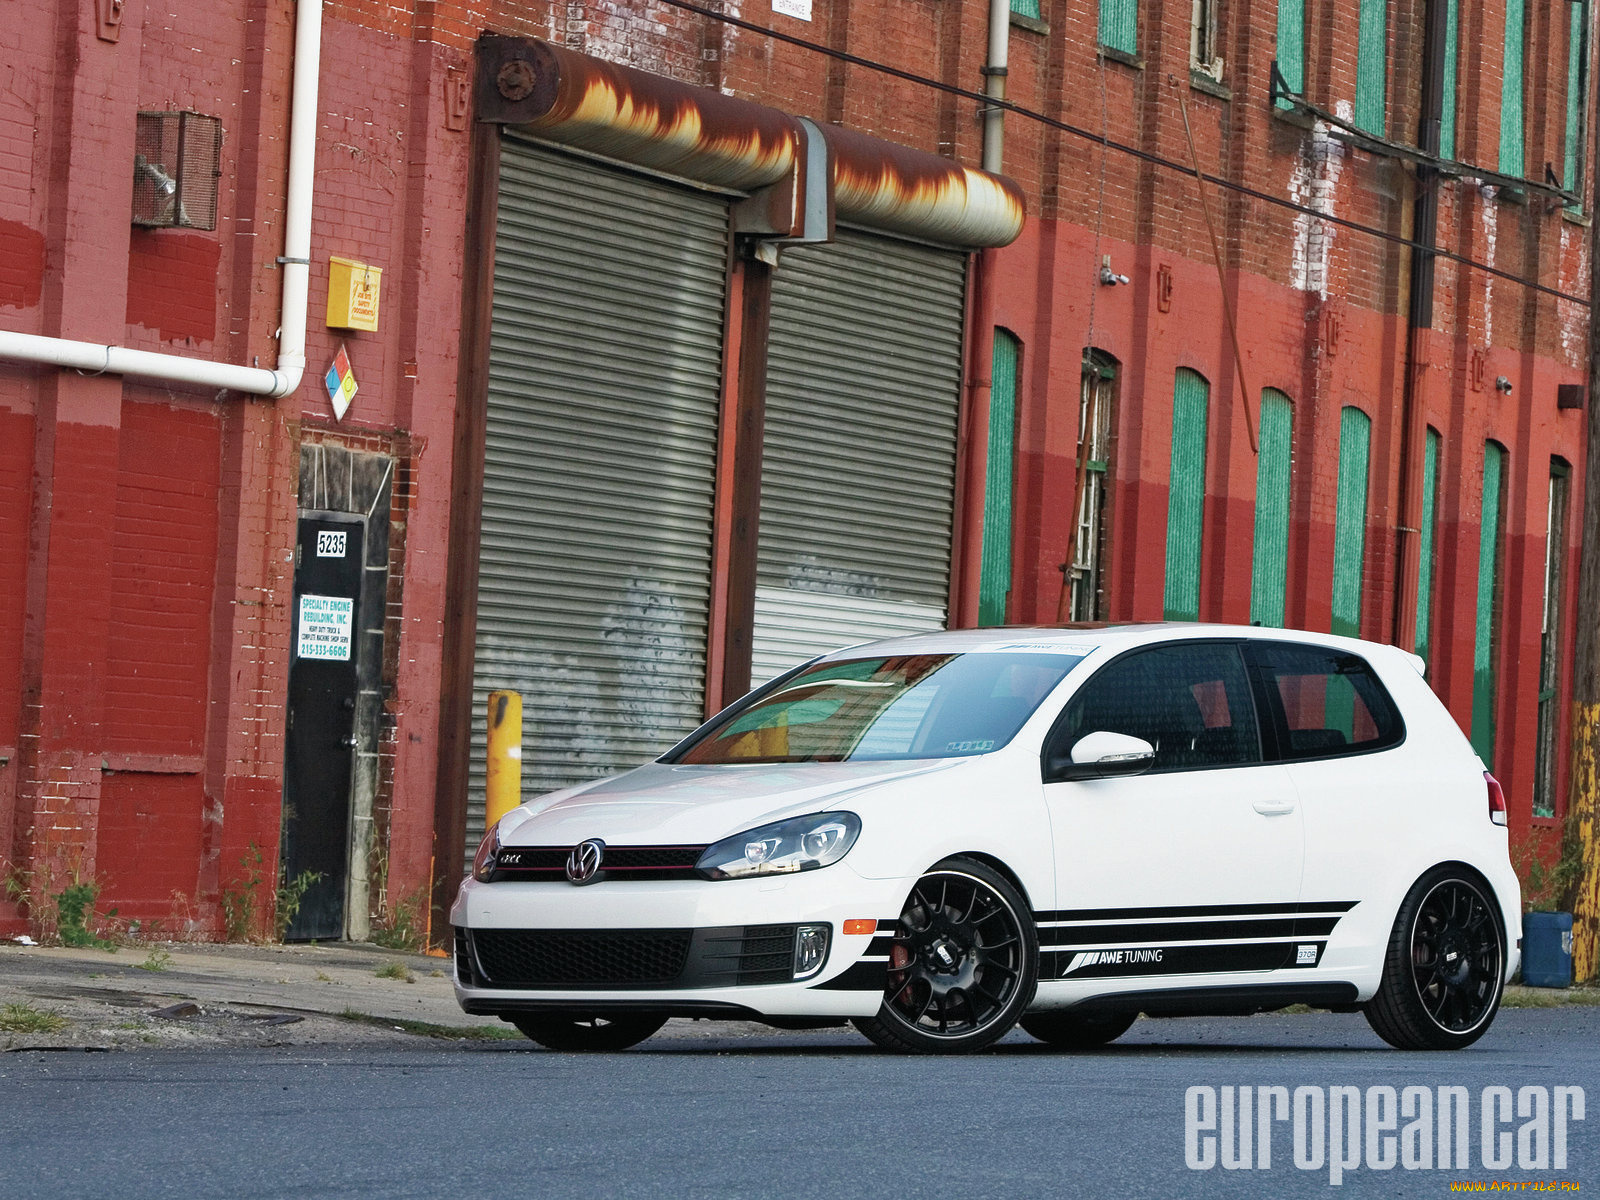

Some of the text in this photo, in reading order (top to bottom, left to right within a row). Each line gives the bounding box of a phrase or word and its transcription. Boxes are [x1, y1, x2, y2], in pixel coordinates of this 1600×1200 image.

[319, 534, 345, 554] 5235
[303, 598, 350, 612] SPECIALTY ENGINE
[337, 614, 347, 625] INC.
[317, 634, 329, 642] MACHINE
[302, 644, 347, 657] 215-333-6606
[1099, 949, 1163, 964] AWE TUNING
